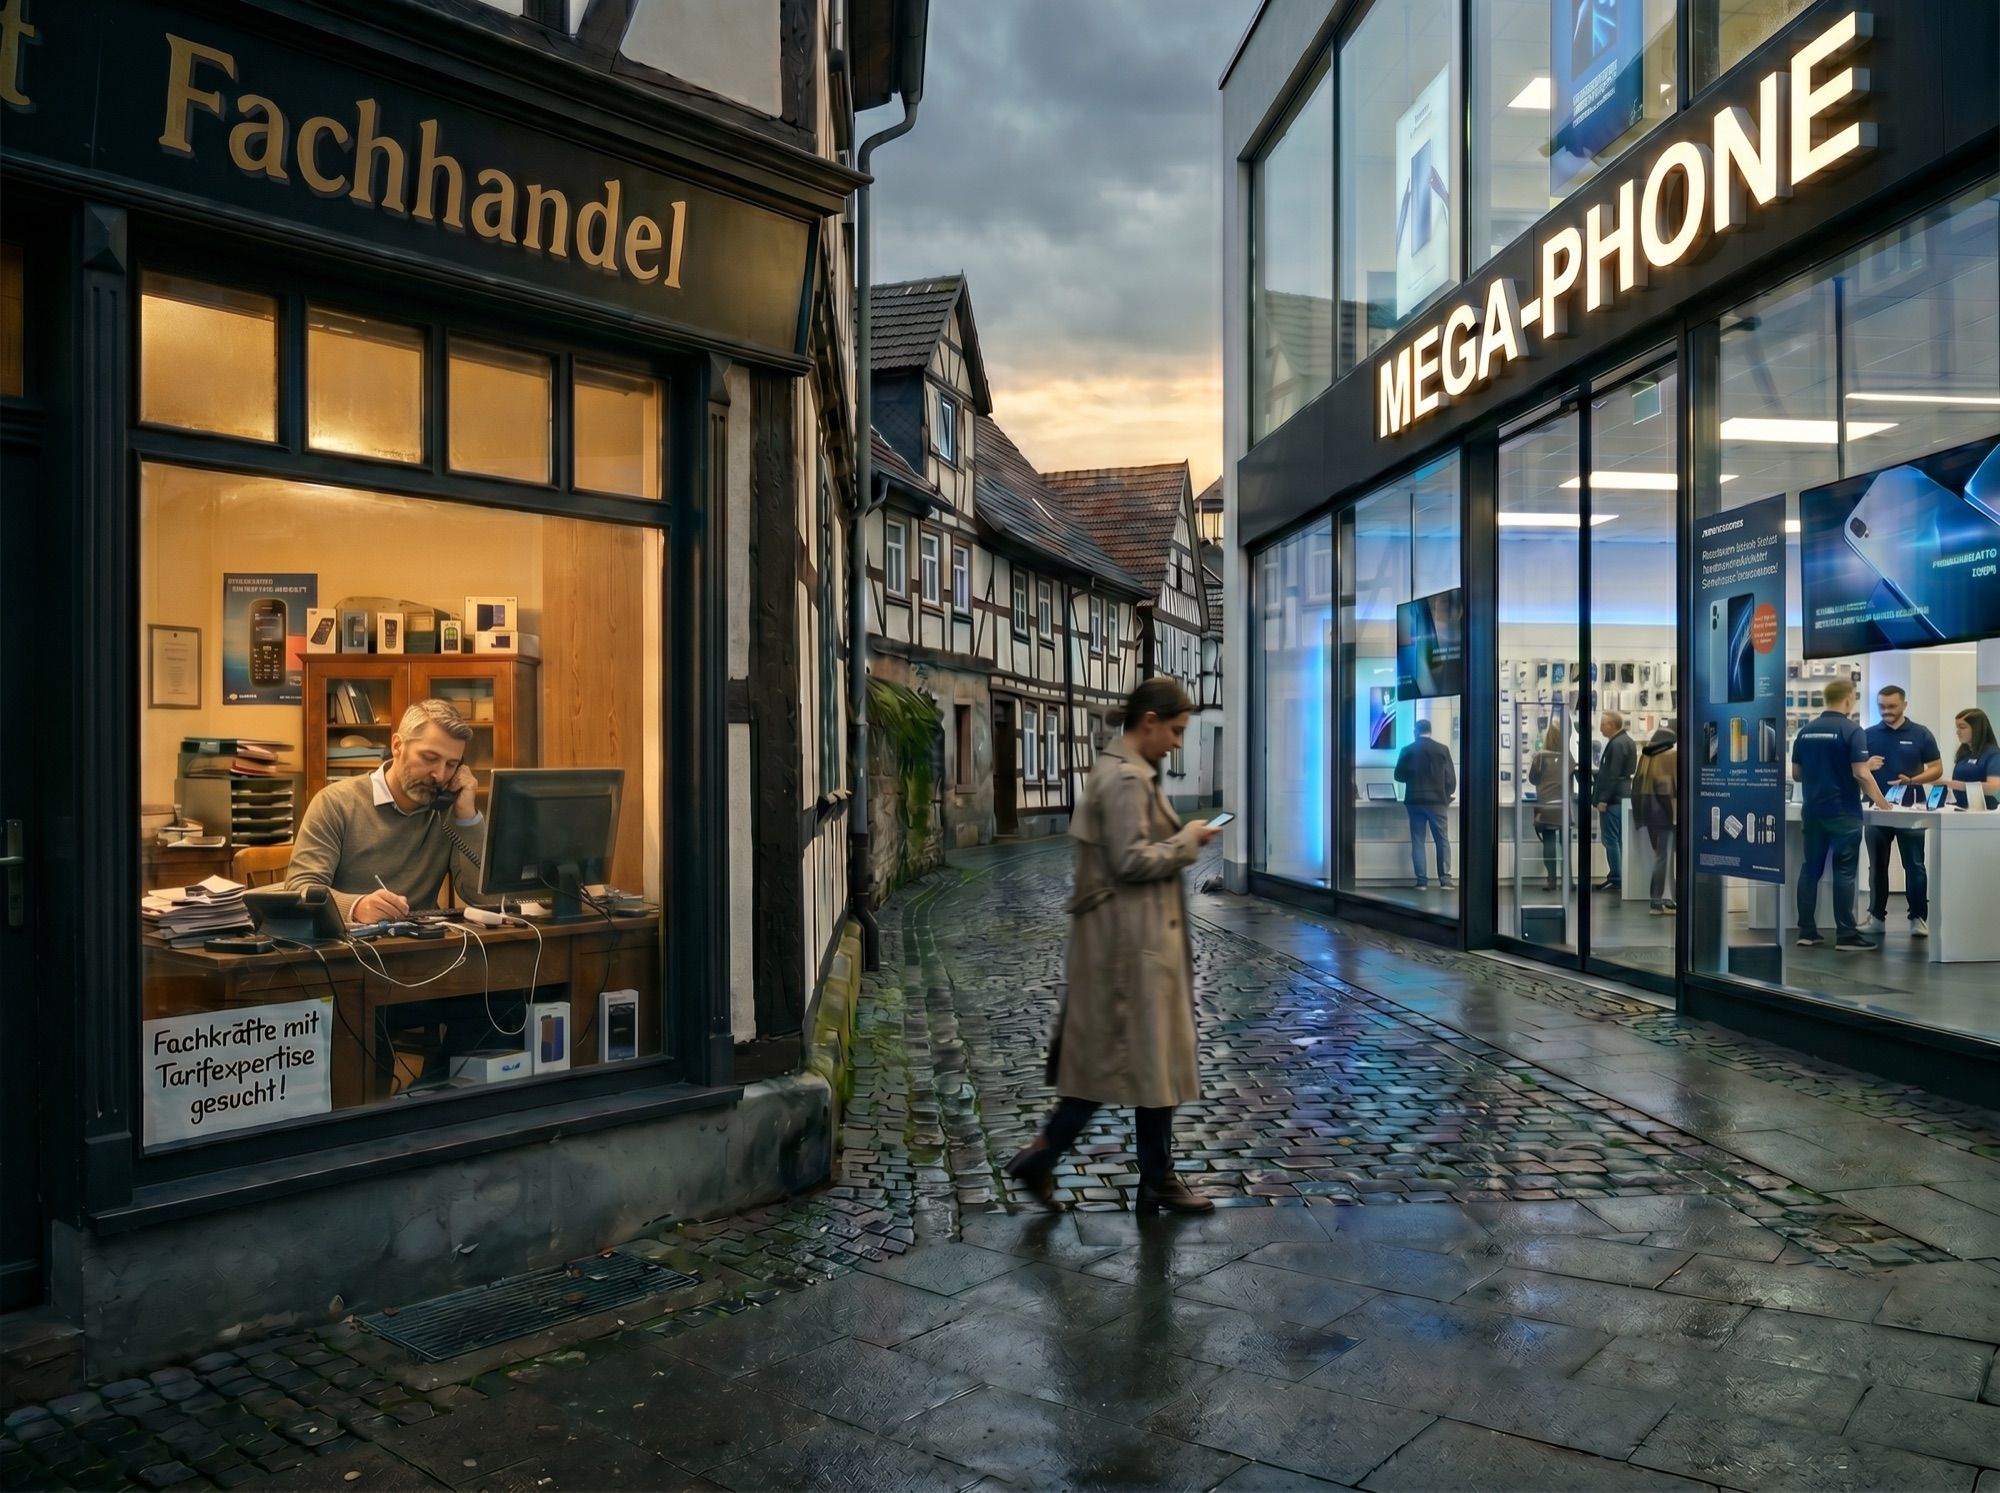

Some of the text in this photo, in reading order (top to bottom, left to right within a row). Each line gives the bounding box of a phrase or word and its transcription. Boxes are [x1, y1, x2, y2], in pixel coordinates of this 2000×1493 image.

[159, 33, 687, 289] Fachhandel
[1379, 11, 1866, 440] MEGA-PHONE
[283, 1010, 320, 1038] mit
[154, 1045, 315, 1088] Tarifexpertise
[190, 1074, 286, 1125] gesucht!
